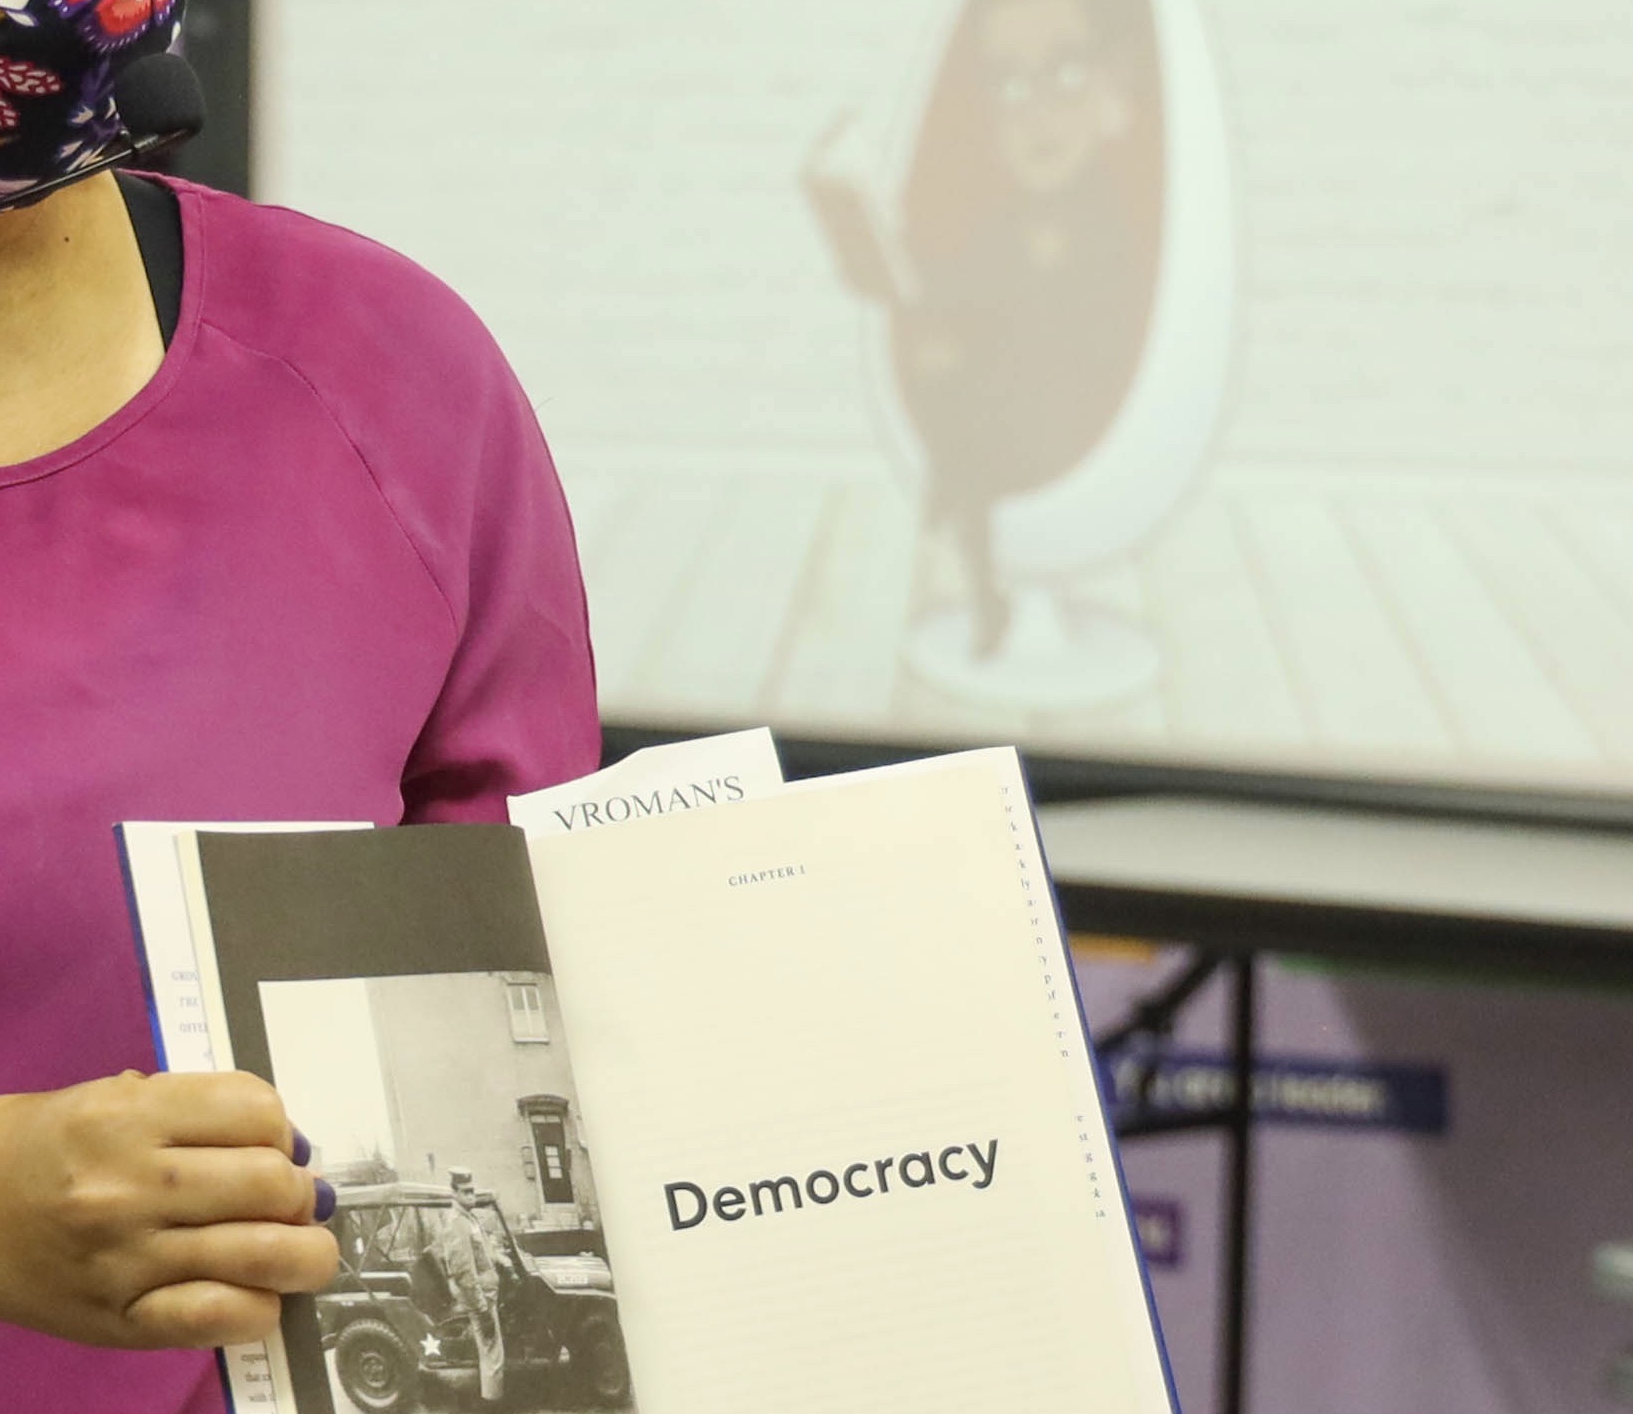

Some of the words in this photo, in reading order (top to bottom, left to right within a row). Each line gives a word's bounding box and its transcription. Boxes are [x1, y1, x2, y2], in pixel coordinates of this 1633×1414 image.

[552, 774, 746, 832] VROMAN'S
[728, 866, 796, 886] CHAPTER
[663, 1137, 999, 1232] Democracy
